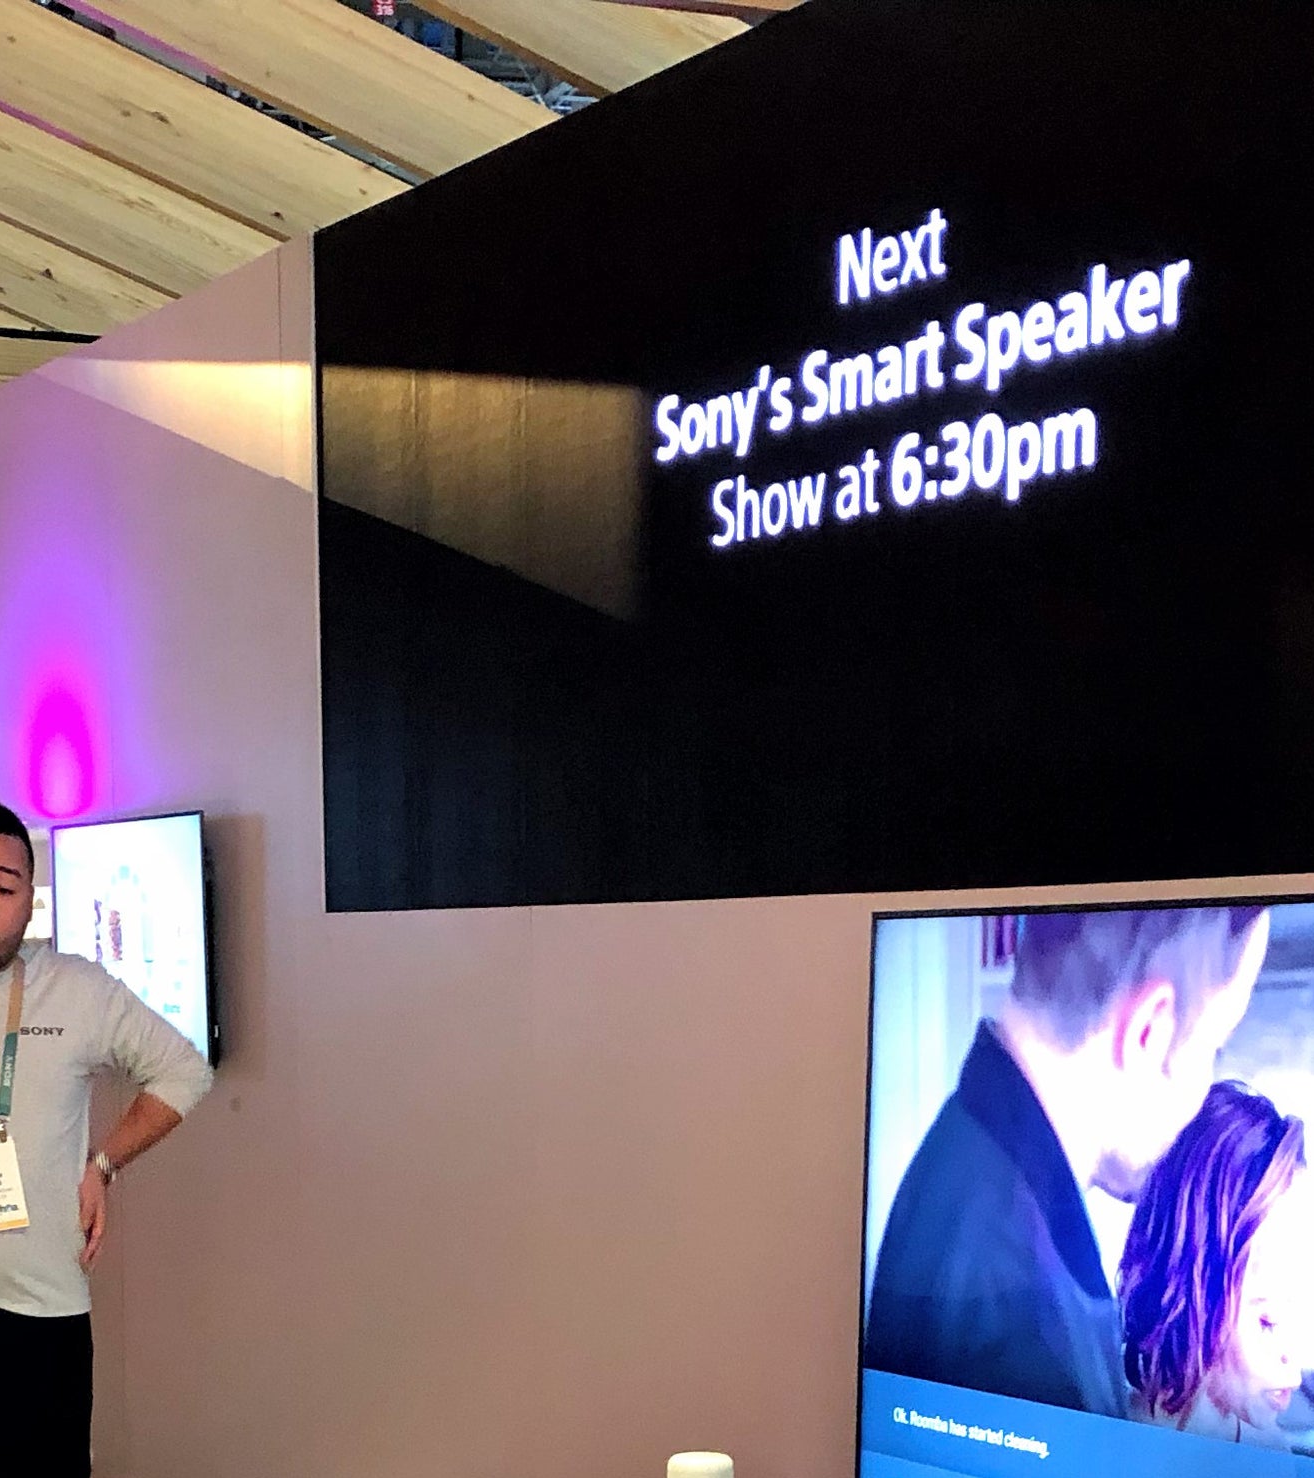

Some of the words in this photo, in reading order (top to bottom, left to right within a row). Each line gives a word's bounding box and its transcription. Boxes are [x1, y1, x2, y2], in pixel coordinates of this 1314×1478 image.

[836, 208, 947, 304] Next
[655, 365, 792, 465] Sony's
[800, 320, 945, 423] Smart
[954, 259, 1190, 391] Speaker
[710, 470, 826, 547] Show
[835, 449, 881, 521] at
[890, 408, 1098, 507] 6:30pm
[20, 1026, 65, 1036] SONY
[2, 1055, 14, 1087] SONY
[909, 1410, 949, 1433] Roomba
[949, 1418, 968, 1438] has
[968, 1425, 1004, 1446] started
